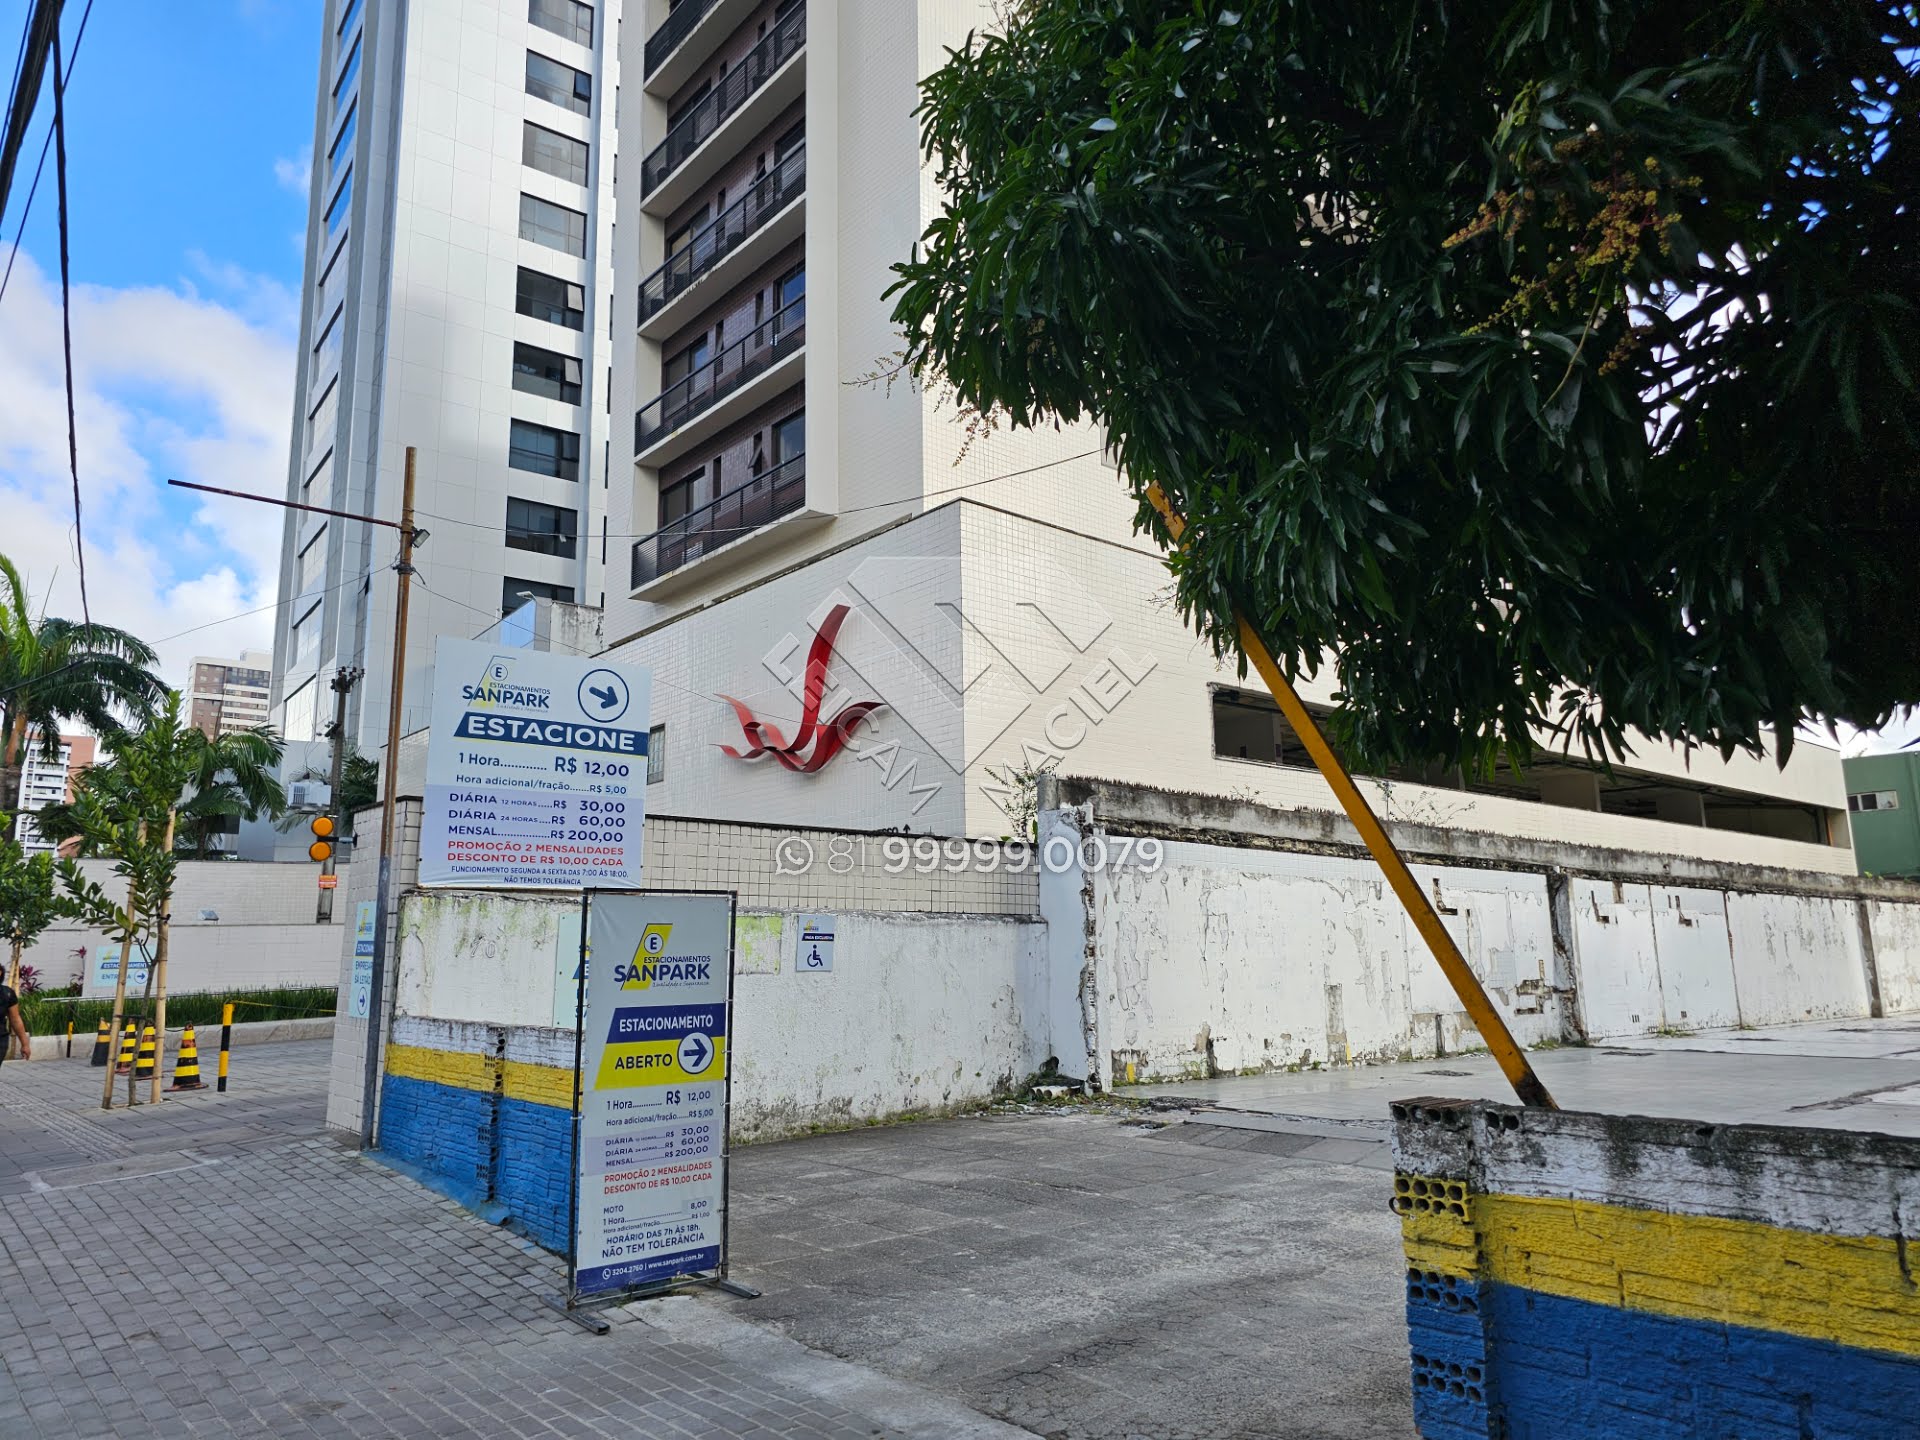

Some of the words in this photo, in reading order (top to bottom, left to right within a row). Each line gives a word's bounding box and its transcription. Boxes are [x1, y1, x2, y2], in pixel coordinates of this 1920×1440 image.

[496, 667, 502, 678] E
[462, 685, 550, 709] SANPARK
[490, 682, 551, 695] ESTACIONAMENTOS
[467, 715, 636, 751] ESTACIONE
[459, 753, 464, 764] 1
[555, 756, 577, 775] R$
[584, 761, 629, 777] 12,00
[456, 775, 482, 785] Hora
[590, 784, 602, 793] R$
[605, 785, 627, 794] 5,00
[450, 792, 498, 804] DIÁRIA
[554, 800, 567, 809] R$
[580, 800, 625, 814] 30,00
[448, 808, 497, 820] DIÁRIA
[552, 816, 566, 825] R$
[579, 816, 626, 828] 60,00
[448, 825, 498, 836] MENSAL
[550, 830, 565, 839] R$
[568, 830, 624, 843] 200,00
[448, 840, 522, 852] PROMOÇÃO
[536, 844, 624, 855] MENSALIDADES
[448, 852, 517, 863] DESCONTO
[540, 856, 555, 865] R$
[559, 856, 589, 866] 10,00
[592, 858, 623, 866] CADA
[452, 866, 509, 874] FUNCIONAMENTO
[511, 866, 541, 874] SEGUNDA
[582, 869, 597, 877] 7:00
[543, 877, 581, 885] TOLERÂNCIA
[650, 937, 658, 950] E
[644, 956, 711, 964] ESTACIONAMENTOS
[614, 964, 710, 982] SANPARK
[619, 1014, 714, 1032] ESTACIONAMENTO
[615, 1054, 673, 1070] ABERTO
[606, 1101, 611, 1110] 1
[666, 1090, 681, 1106] R$
[688, 1090, 711, 1102] 12,00
[606, 1118, 623, 1126] Hora
[688, 1110, 697, 1118] R$
[698, 1108, 714, 1118] 5,00
[606, 1136, 634, 1146] DIÁRIA
[682, 1126, 709, 1137] 30,00
[606, 1147, 634, 1157] DIÁRIA
[664, 1141, 674, 1149] R$
[682, 1136, 710, 1146] 60,00
[664, 1151, 674, 1159] R$
[676, 1145, 709, 1157] 200,00
[604, 1168, 649, 1183] PROMOÇÃO
[651, 1168, 656, 1177] 2
[658, 1161, 713, 1176] MENSALIDADES
[604, 1182, 646, 1195] DESCONTO
[648, 1180, 658, 1189] DE
[660, 1178, 670, 1186] R$
[672, 1176, 691, 1185] 10,00
[692, 1172, 713, 1182] CADA
[604, 1205, 624, 1215] MOTO
[604, 1218, 607, 1226] 1
[690, 1200, 708, 1210] 8,00
[606, 1232, 644, 1245] HORÁRIO
[646, 1228, 662, 1239] DAS
[664, 1228, 673, 1237] 7h
[674, 1224, 685, 1233] ÀS
[688, 1224, 701, 1232] 18h.
[602, 1246, 623, 1259] NÃO
[626, 1242, 645, 1253] TEM
[648, 1232, 705, 1250] TOLERÂNCIA
[648, 1253, 705, 1269] www.sanpark.com.br
